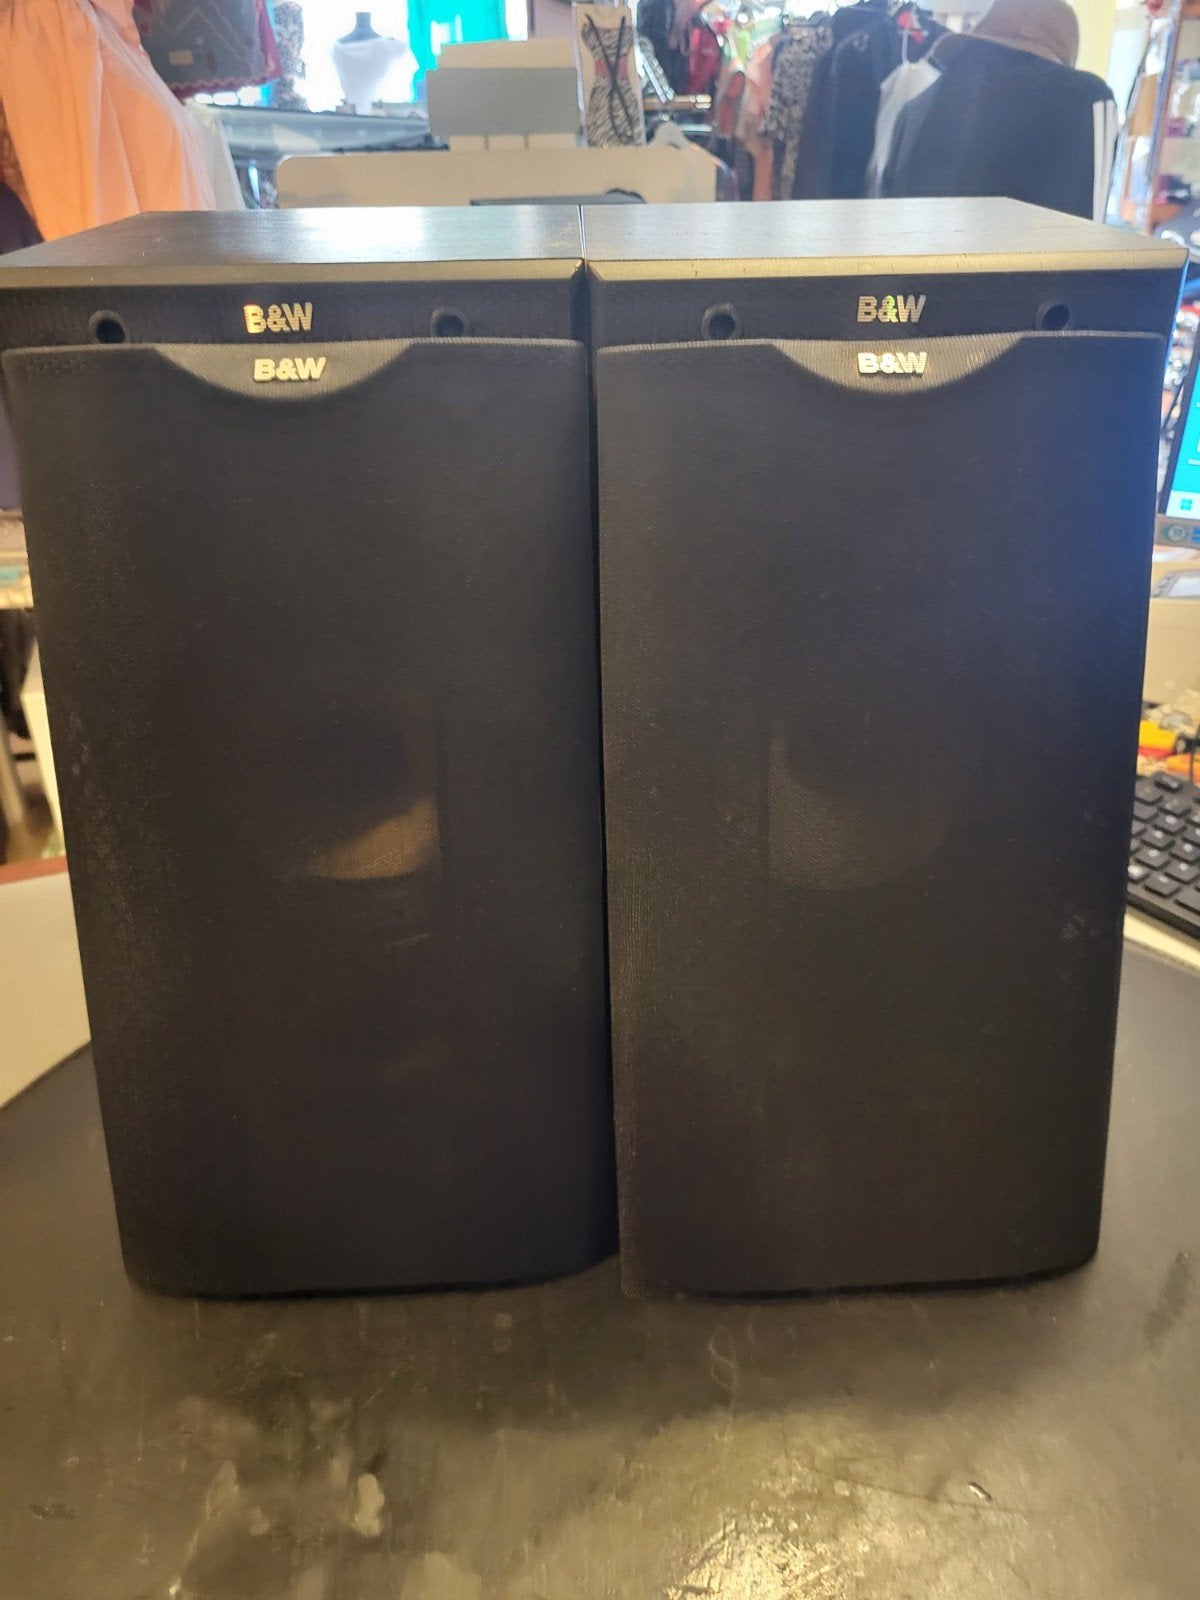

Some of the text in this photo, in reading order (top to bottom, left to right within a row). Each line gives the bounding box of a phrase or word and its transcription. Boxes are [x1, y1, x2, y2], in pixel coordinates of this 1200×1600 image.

[243, 302, 313, 334] B&W
[857, 294, 926, 323] B&W
[253, 356, 327, 382] B&W
[857, 351, 927, 374] B&W
